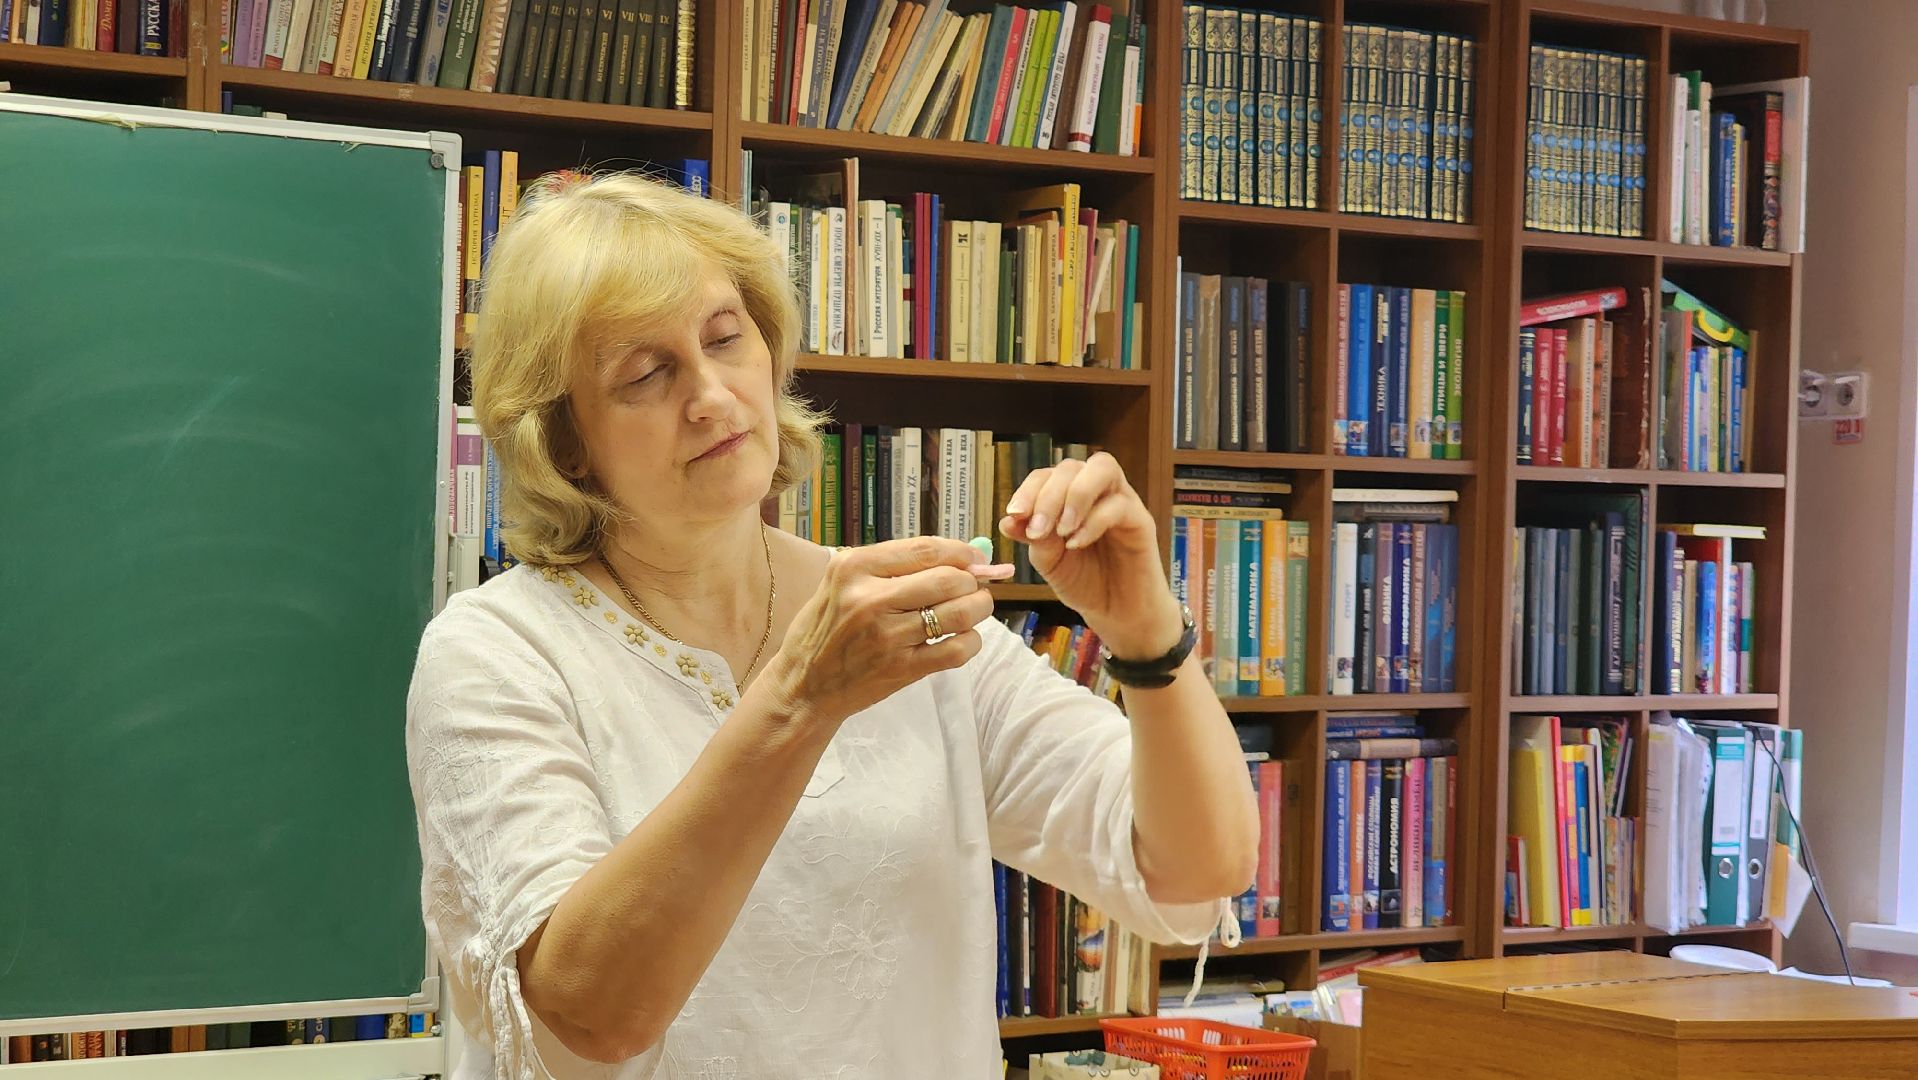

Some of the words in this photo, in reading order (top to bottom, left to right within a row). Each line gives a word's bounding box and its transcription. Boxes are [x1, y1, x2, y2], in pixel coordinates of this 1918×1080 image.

[602, 8, 613, 20] VI
[621, 10, 635, 23] VII
[471, 193, 481, 227] ТУРИЗМА
[471, 229, 479, 265] ИСТОРИЯ
[833, 226, 843, 252] ПОСЛЕ
[833, 254, 843, 287] СМЕРТИ
[833, 289, 843, 330] ПУШКИНА
[1438, 324, 1447, 358] ЗВЕРИ
[1438, 360, 1446, 369] И
[1453, 339, 1462, 397] ЭКОЛОГИЯ
[1376, 366, 1387, 413] ТЕХНИКА
[1437, 371, 1446, 411] ПТИЦЫ
[944, 438, 954, 456] ВЕКА
[958, 434, 969, 451] ВЕКА
[958, 453, 969, 463] XX
[944, 458, 953, 468] XX
[943, 470, 953, 514] ЛИТЕРАТУРА
[957, 466, 968, 510] ЛИТЕРАТУРА
[957, 513, 967, 540] УССКАЯ
[1206, 569, 1215, 632] ОБЩЕСТВО
[1248, 562, 1257, 639] МАТЕМАТИКА
[1382, 575, 1392, 625] ФИЗИКА
[1401, 558, 1410, 645] ИНФОРМАТИКА
[1389, 797, 1400, 873] АСТРОНОМИЯ
